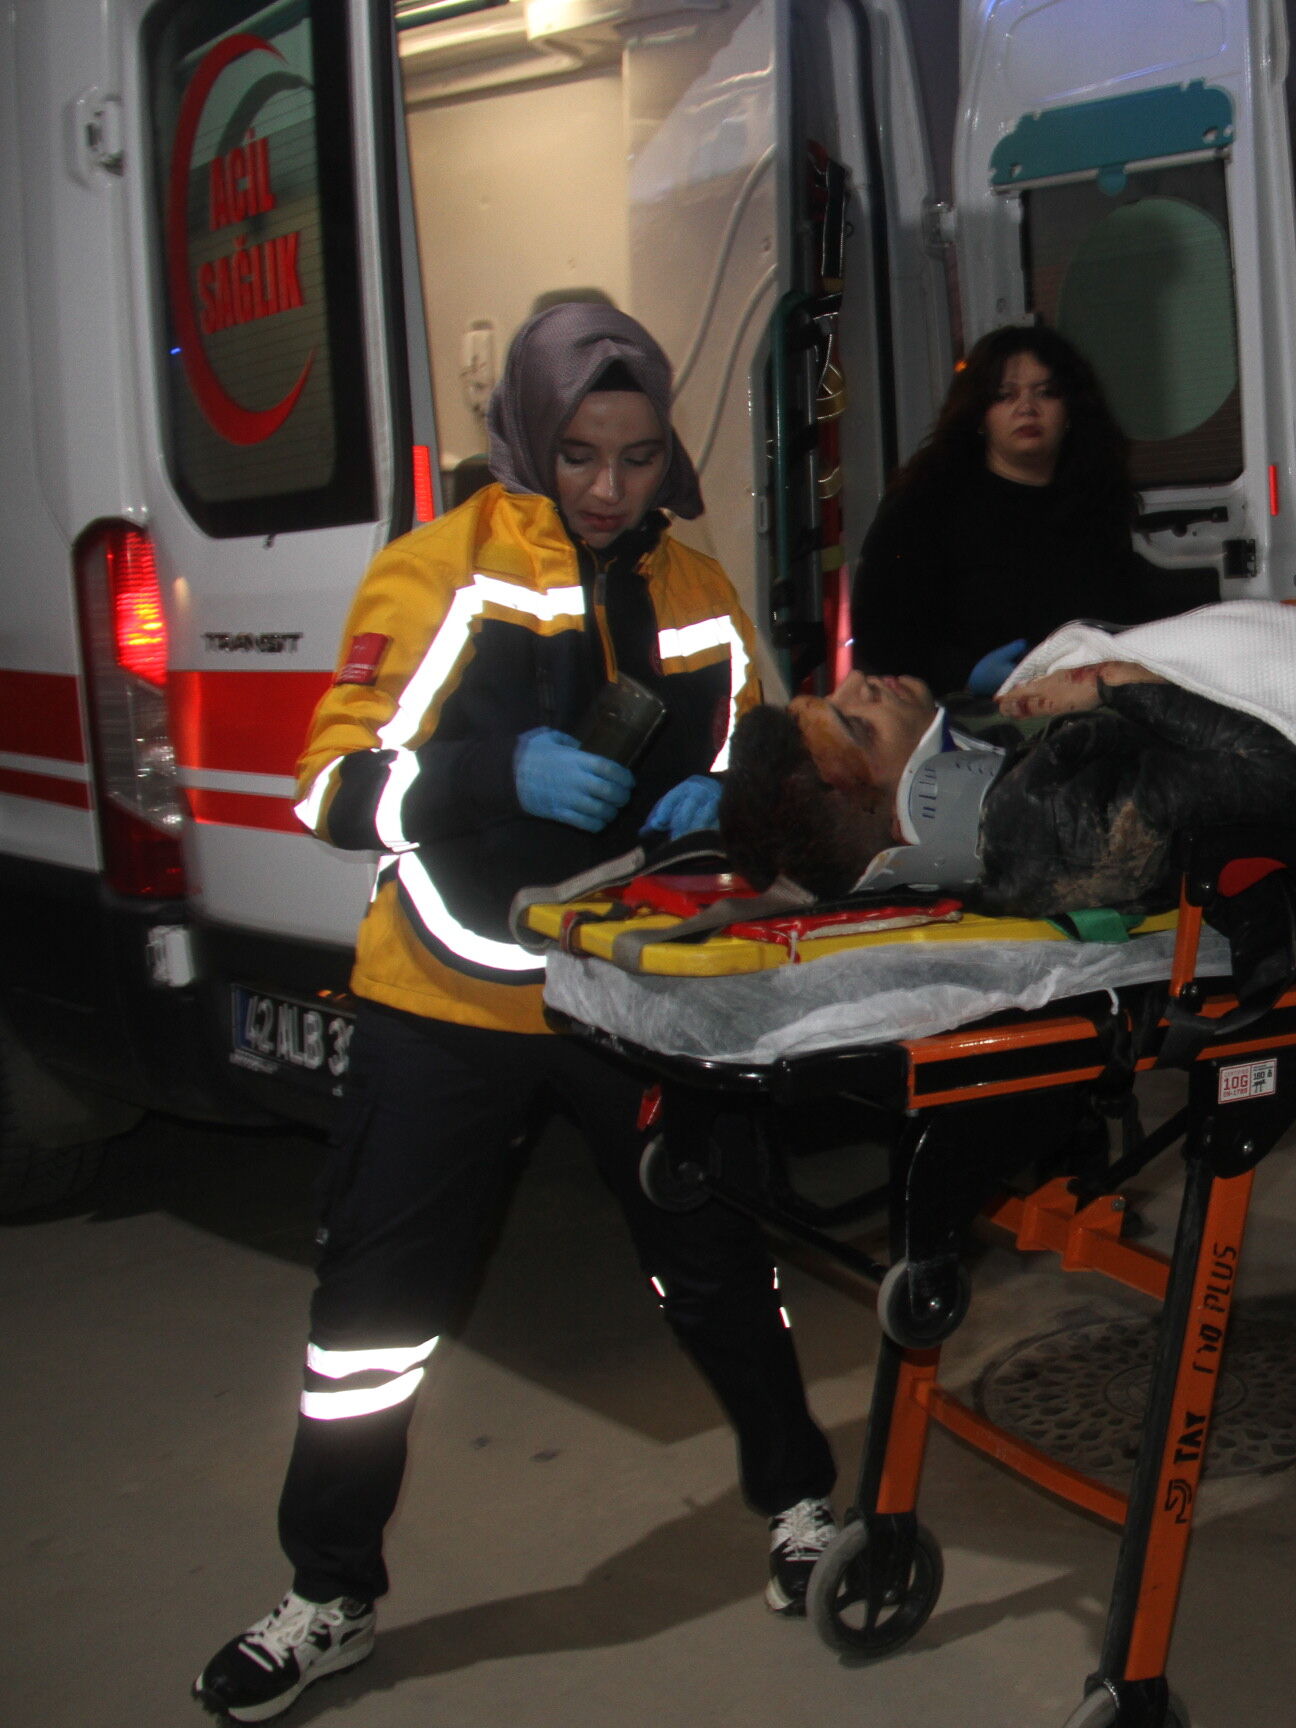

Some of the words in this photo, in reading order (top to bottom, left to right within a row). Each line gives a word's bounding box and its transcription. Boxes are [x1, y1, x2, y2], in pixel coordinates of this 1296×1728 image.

[199, 233, 304, 334] SAĞLIK
[202, 632, 303, 652] TRANSIT
[1223, 1074, 1248, 1090] 10G
[1174, 1411, 1206, 1464] TAY
[1203, 1243, 1237, 1313] PLUS
